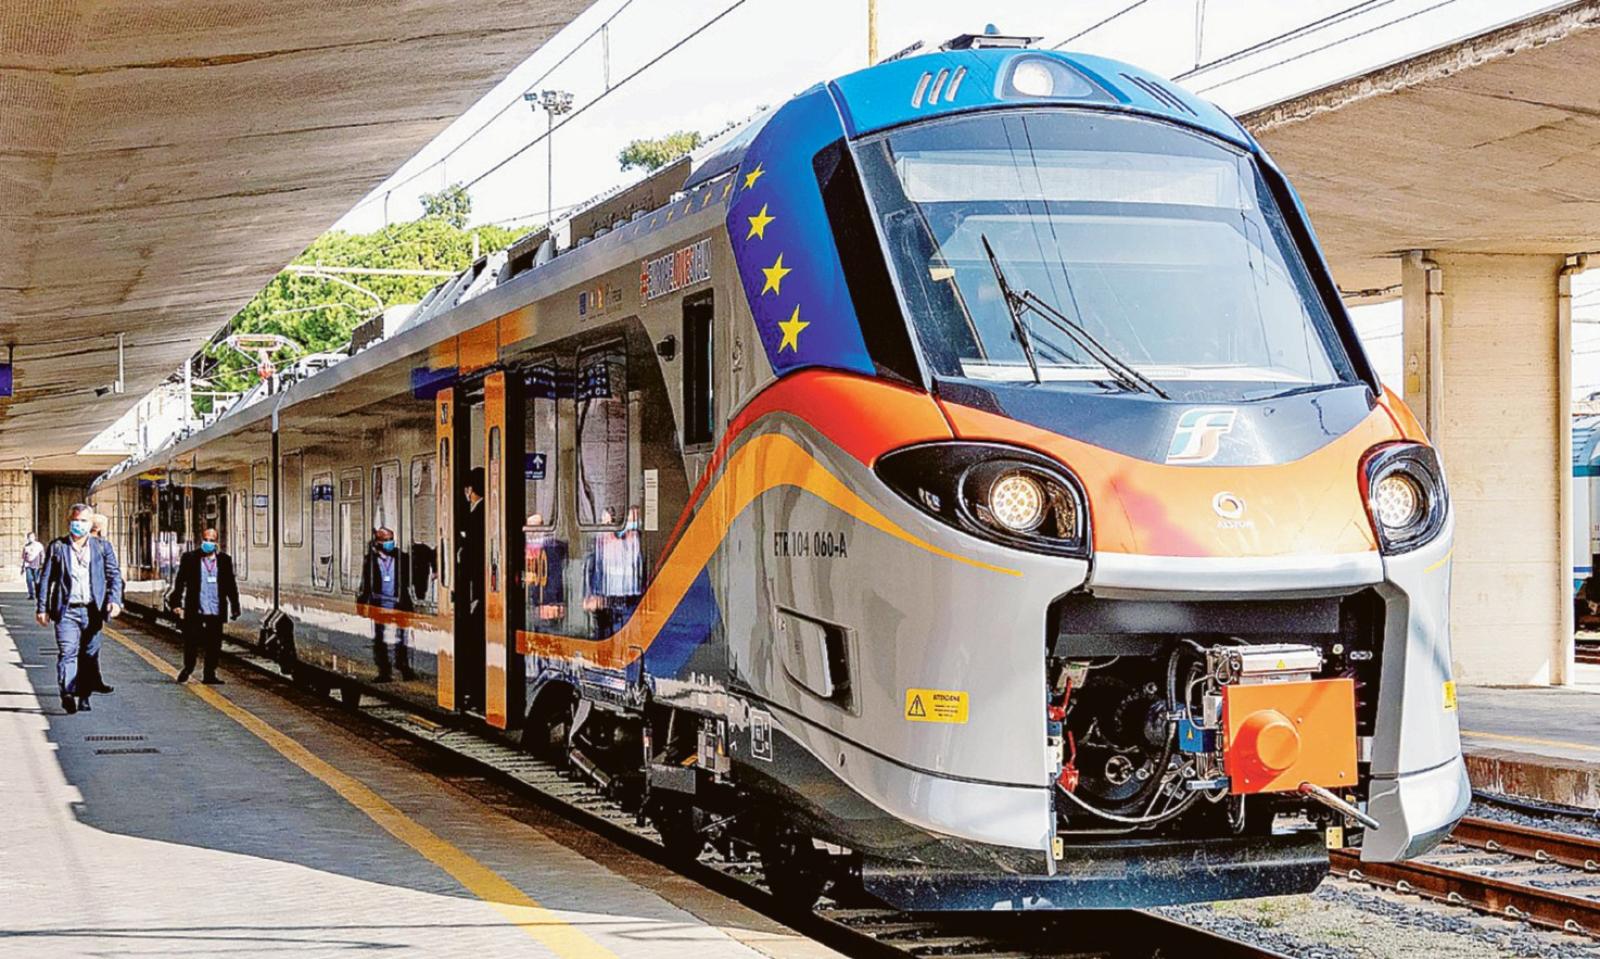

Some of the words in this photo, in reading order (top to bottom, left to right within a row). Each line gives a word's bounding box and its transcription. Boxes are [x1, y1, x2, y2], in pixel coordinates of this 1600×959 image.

[774, 531, 789, 557] ETR
[792, 531, 809, 557] 104
[813, 531, 848, 558] 060-A
